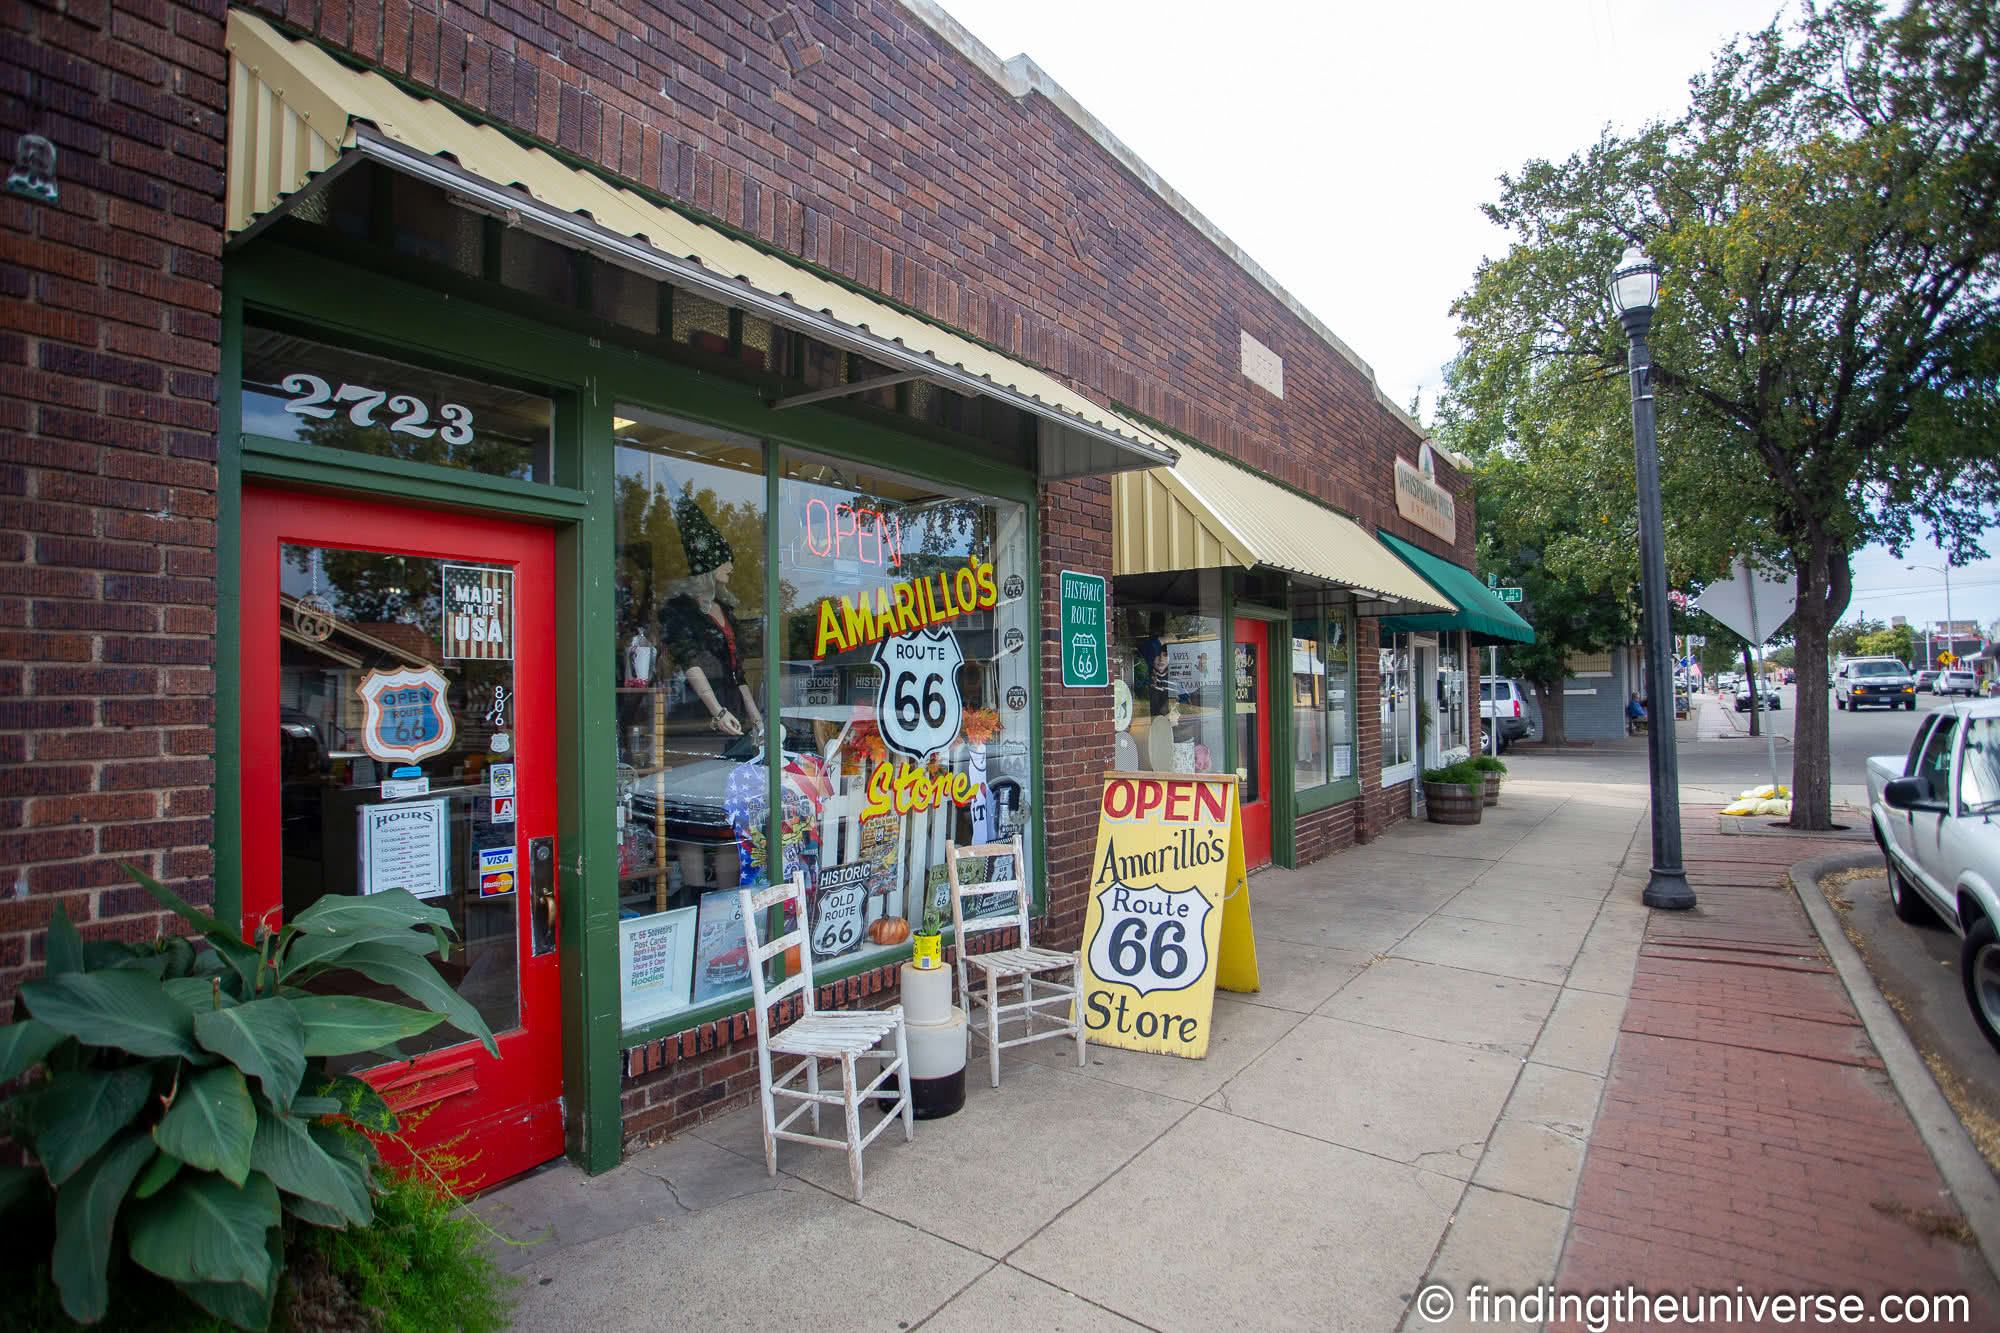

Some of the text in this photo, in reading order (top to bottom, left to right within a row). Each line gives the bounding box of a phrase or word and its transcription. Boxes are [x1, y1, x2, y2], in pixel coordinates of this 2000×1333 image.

[281, 373, 475, 445] 2723
[806, 498, 901, 568] OPEN
[454, 584, 503, 605] MADE
[1064, 579, 1102, 602] HISTORIC
[463, 603, 495, 616] IN THE
[813, 555, 998, 660] AMARILLO'S
[1071, 605, 1097, 625] ROUTE
[454, 616, 503, 643] USA
[896, 643, 945, 661] ROUTE
[1078, 654, 1092, 673] 66
[798, 677, 839, 688] HISTORIC
[384, 690, 432, 705] OPEN
[808, 695, 828, 705] OLD
[895, 671, 946, 732] 66
[393, 708, 424, 719] ROUTE
[396, 720, 427, 742] 66
[860, 761, 980, 822] Store
[1103, 779, 1228, 823] OPEN
[376, 811, 433, 829] HOURS
[487, 855, 509, 865] VISA
[1095, 828, 1225, 888] Amarillo's
[820, 863, 870, 886] HISTORIC
[831, 893, 854, 908] OLD
[937, 896, 947, 906] 66
[1112, 887, 1189, 918] Route
[825, 905, 856, 921] ROUTE
[821, 920, 853, 948] 66
[1108, 917, 1188, 979] 66
[631, 973, 665, 987] Hoodies
[1084, 990, 1198, 1043] Store
